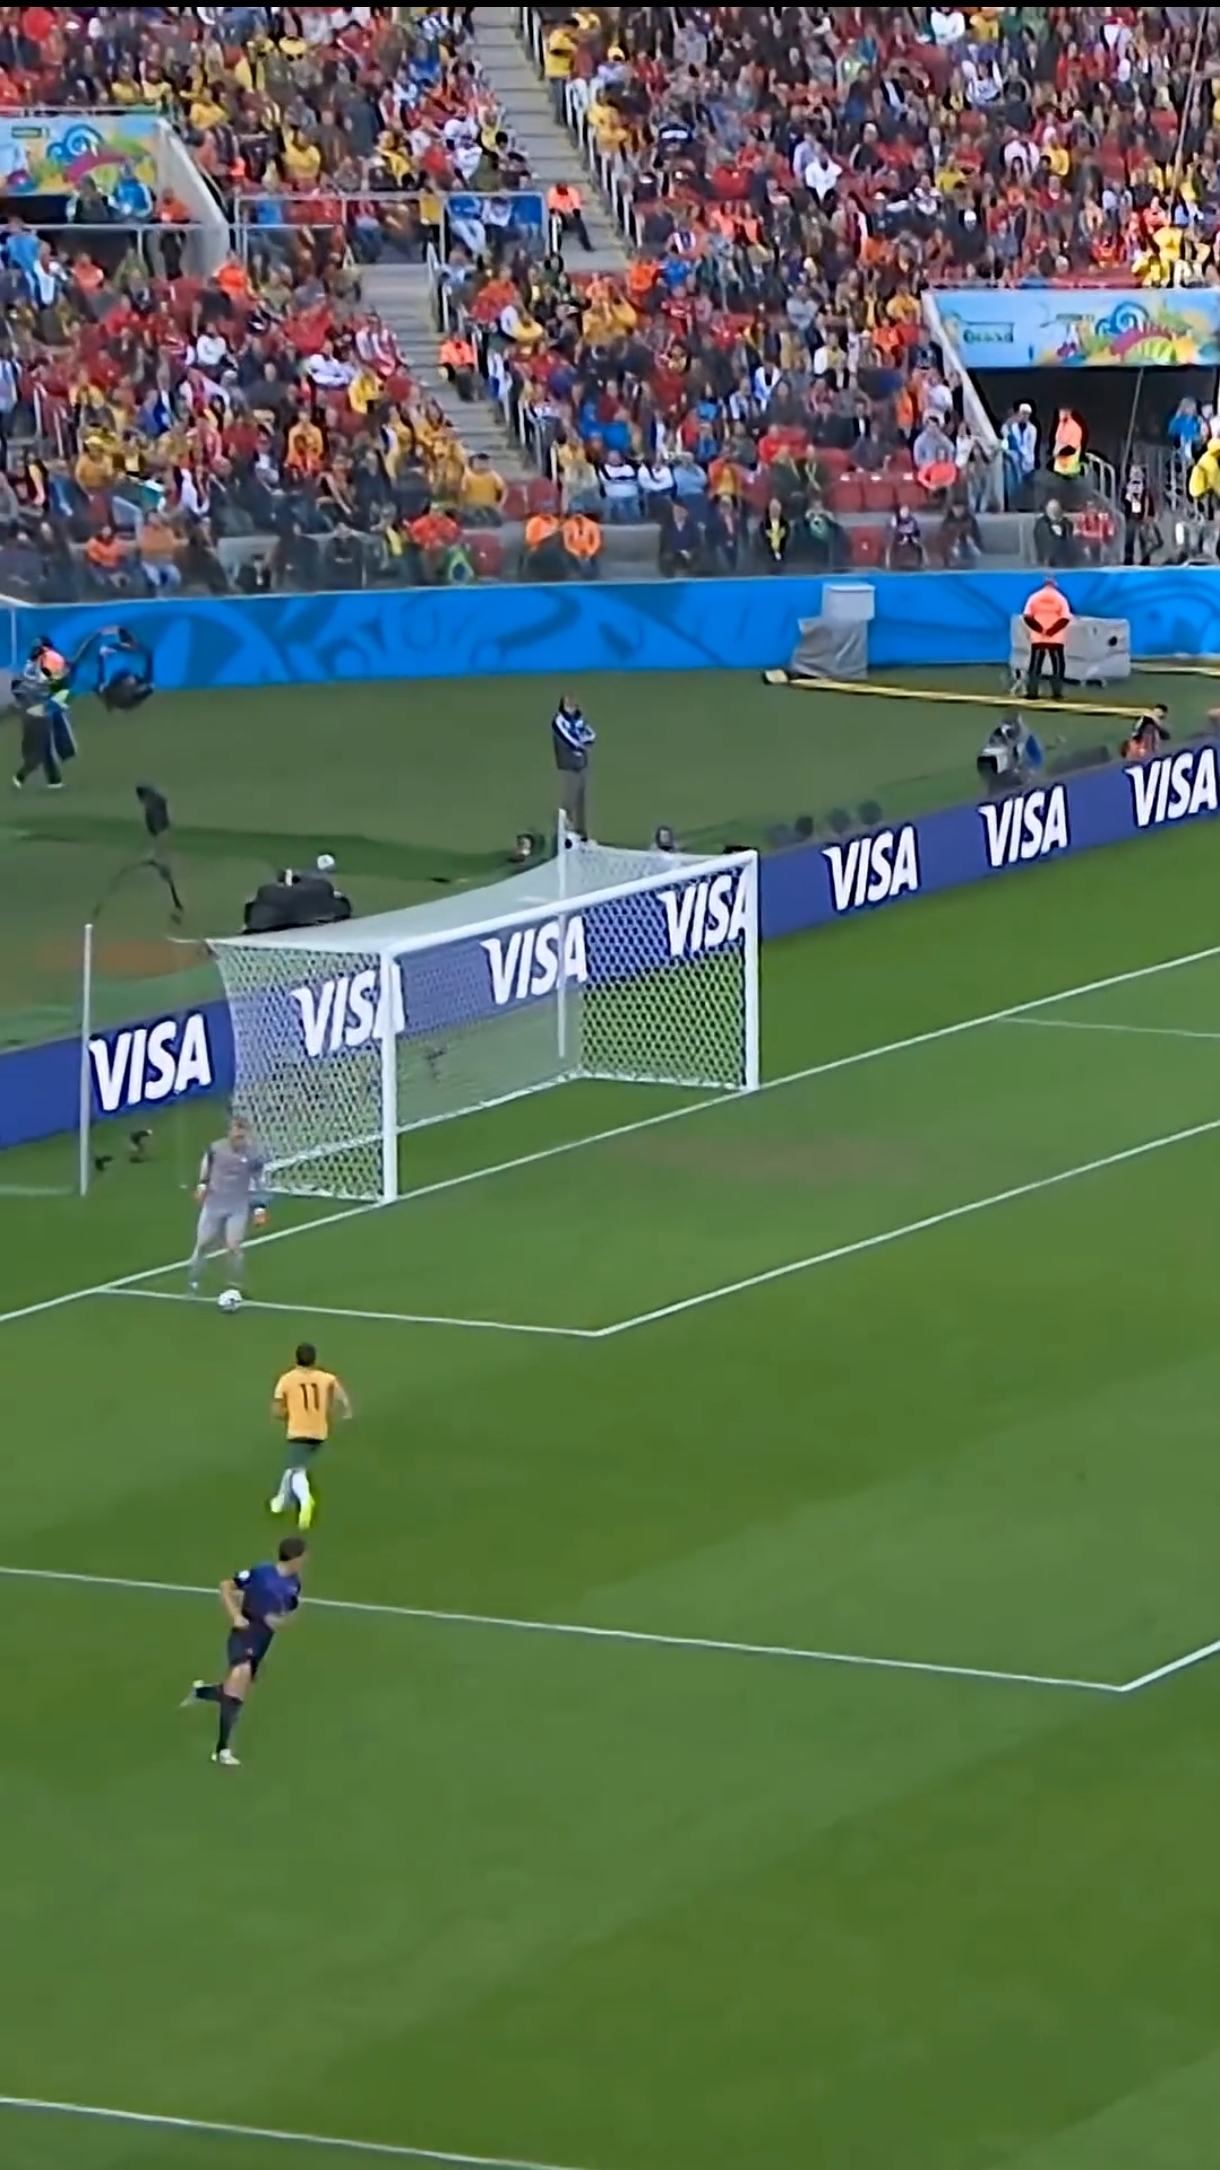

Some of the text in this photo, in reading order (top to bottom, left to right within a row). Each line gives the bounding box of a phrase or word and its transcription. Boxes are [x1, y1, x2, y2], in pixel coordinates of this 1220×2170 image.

[979, 785, 1067, 867] VISA
[1125, 748, 1217, 827] VISA
[822, 827, 918, 911] VISA
[480, 916, 588, 1005] VISA
[89, 1014, 212, 1111] VISA
[300, 1383, 319, 1411] 11
